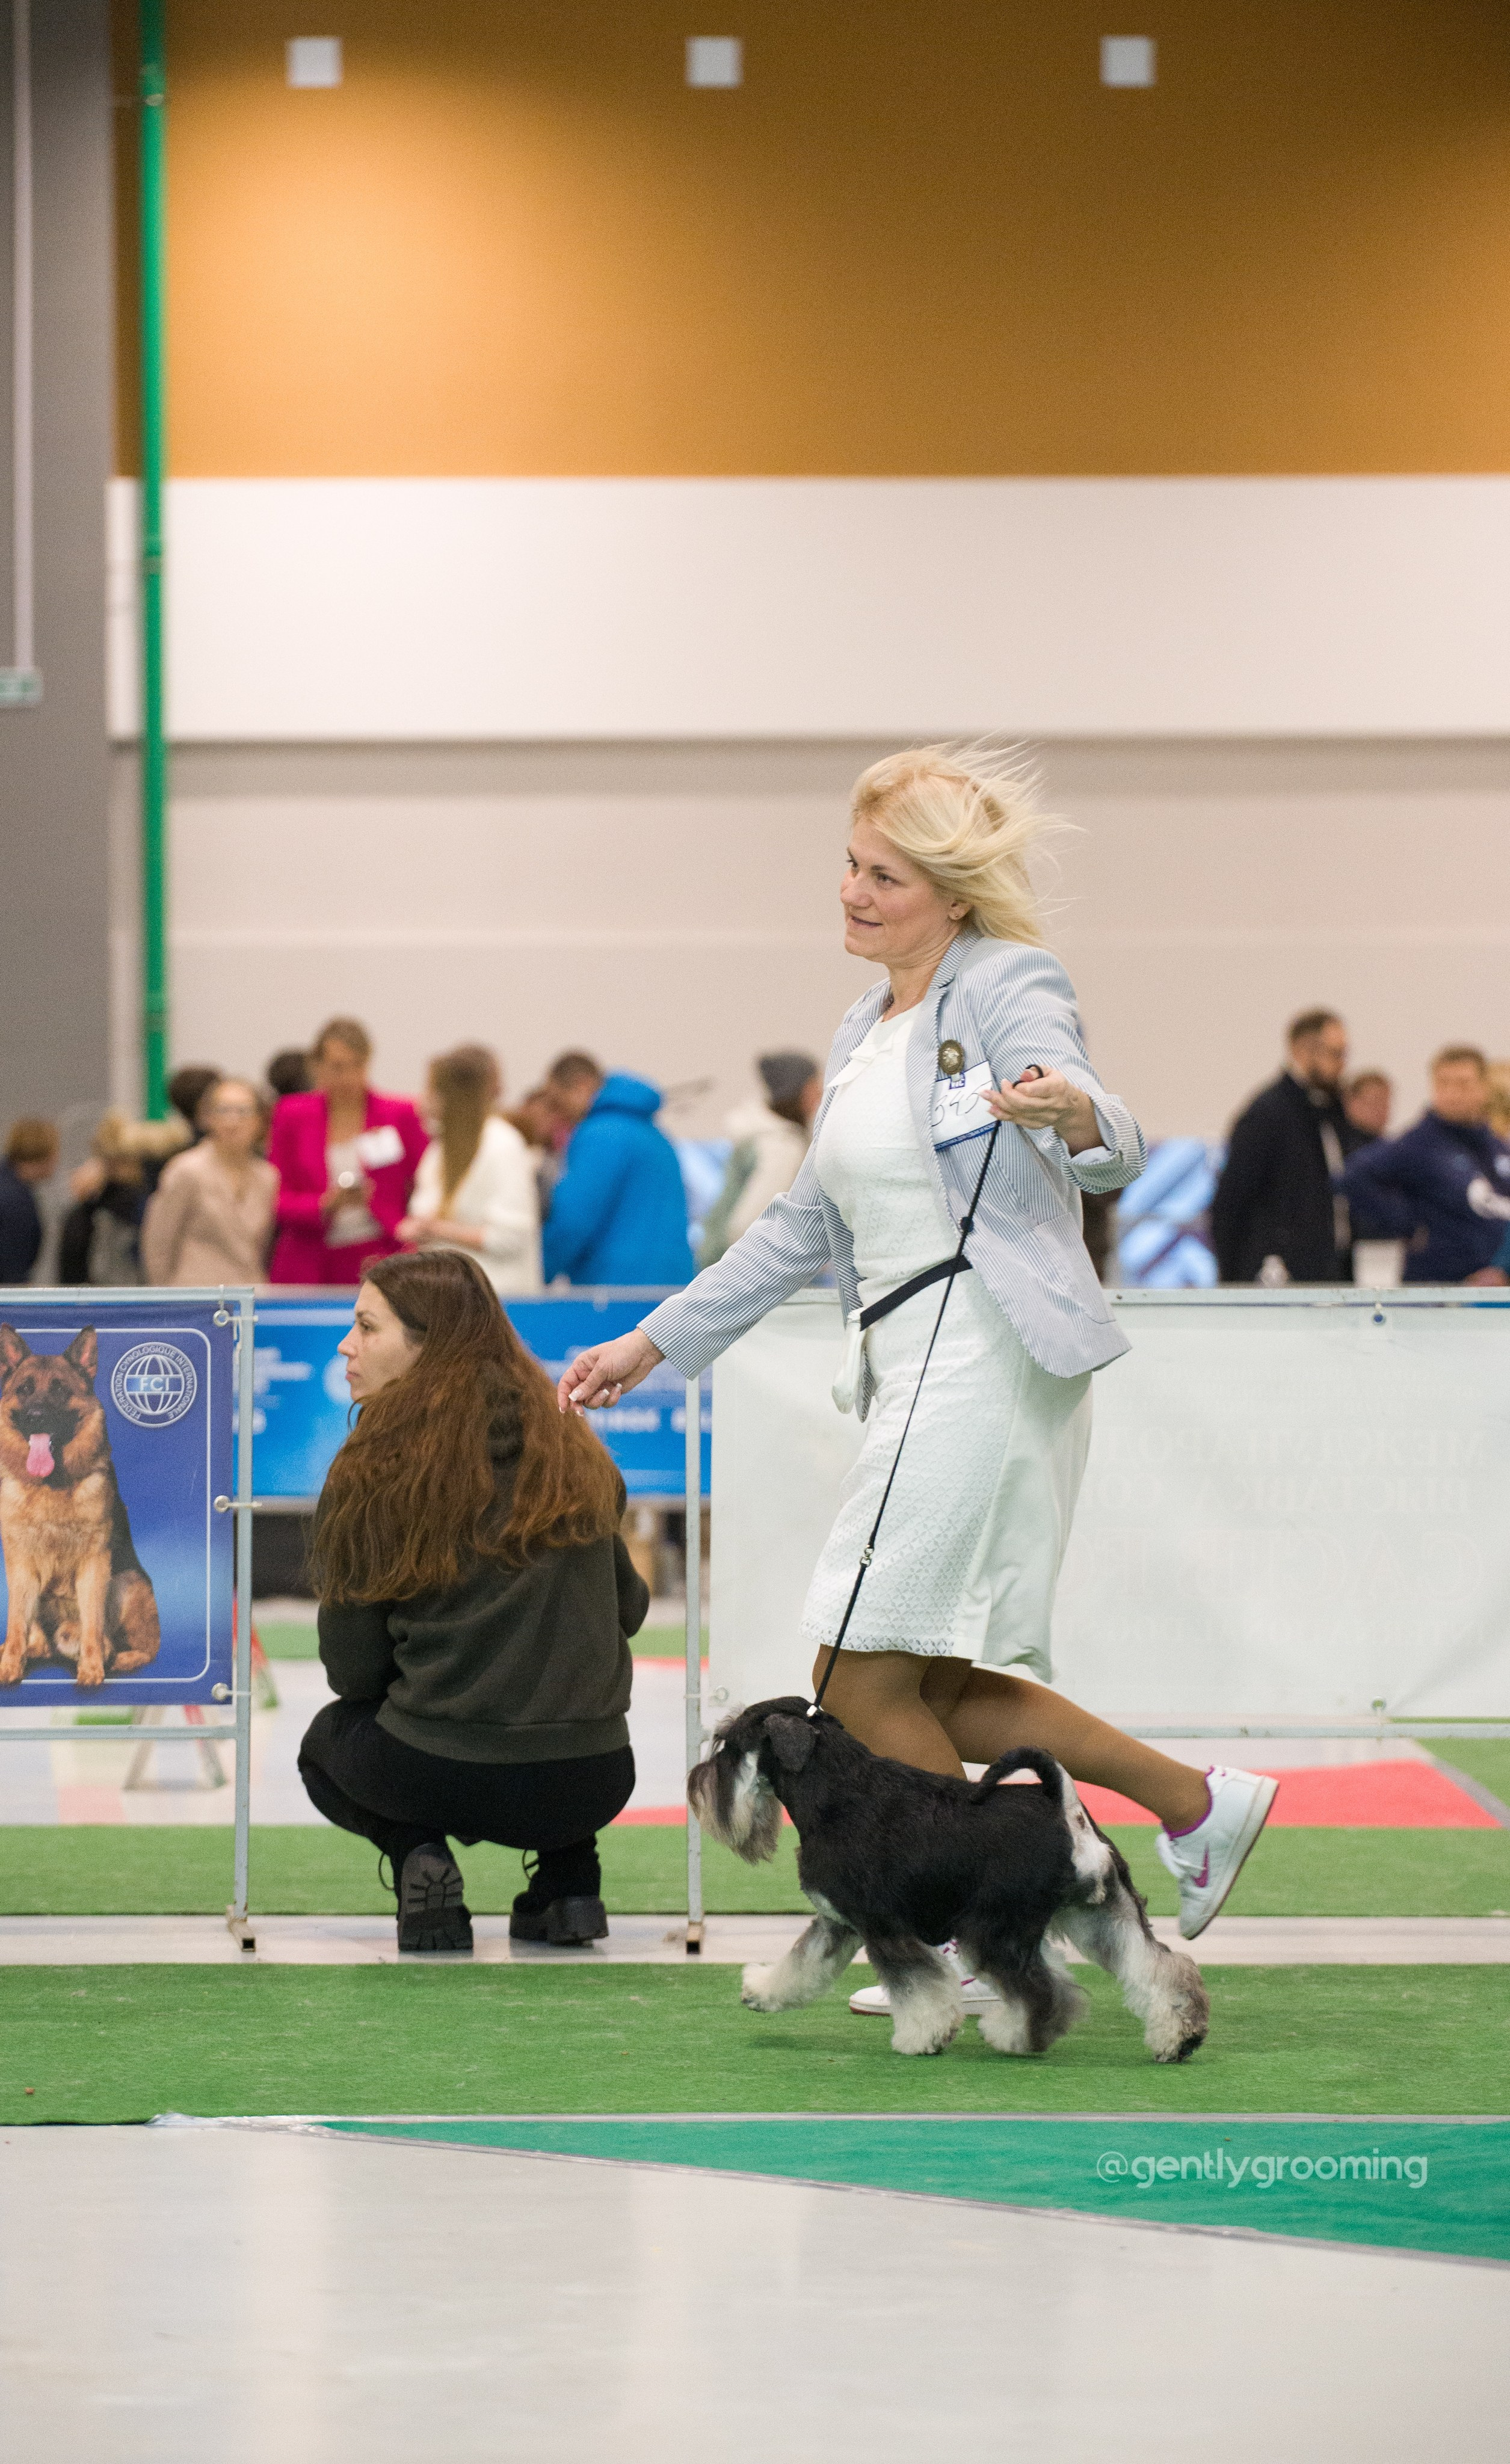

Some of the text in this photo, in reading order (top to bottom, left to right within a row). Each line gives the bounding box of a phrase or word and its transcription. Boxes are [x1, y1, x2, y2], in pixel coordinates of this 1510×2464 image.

[120, 1345, 176, 1372] CYNOLOGIQUE
[167, 1354, 195, 1420] INTERNATIONALE
[140, 1376, 170, 1391] FCI
